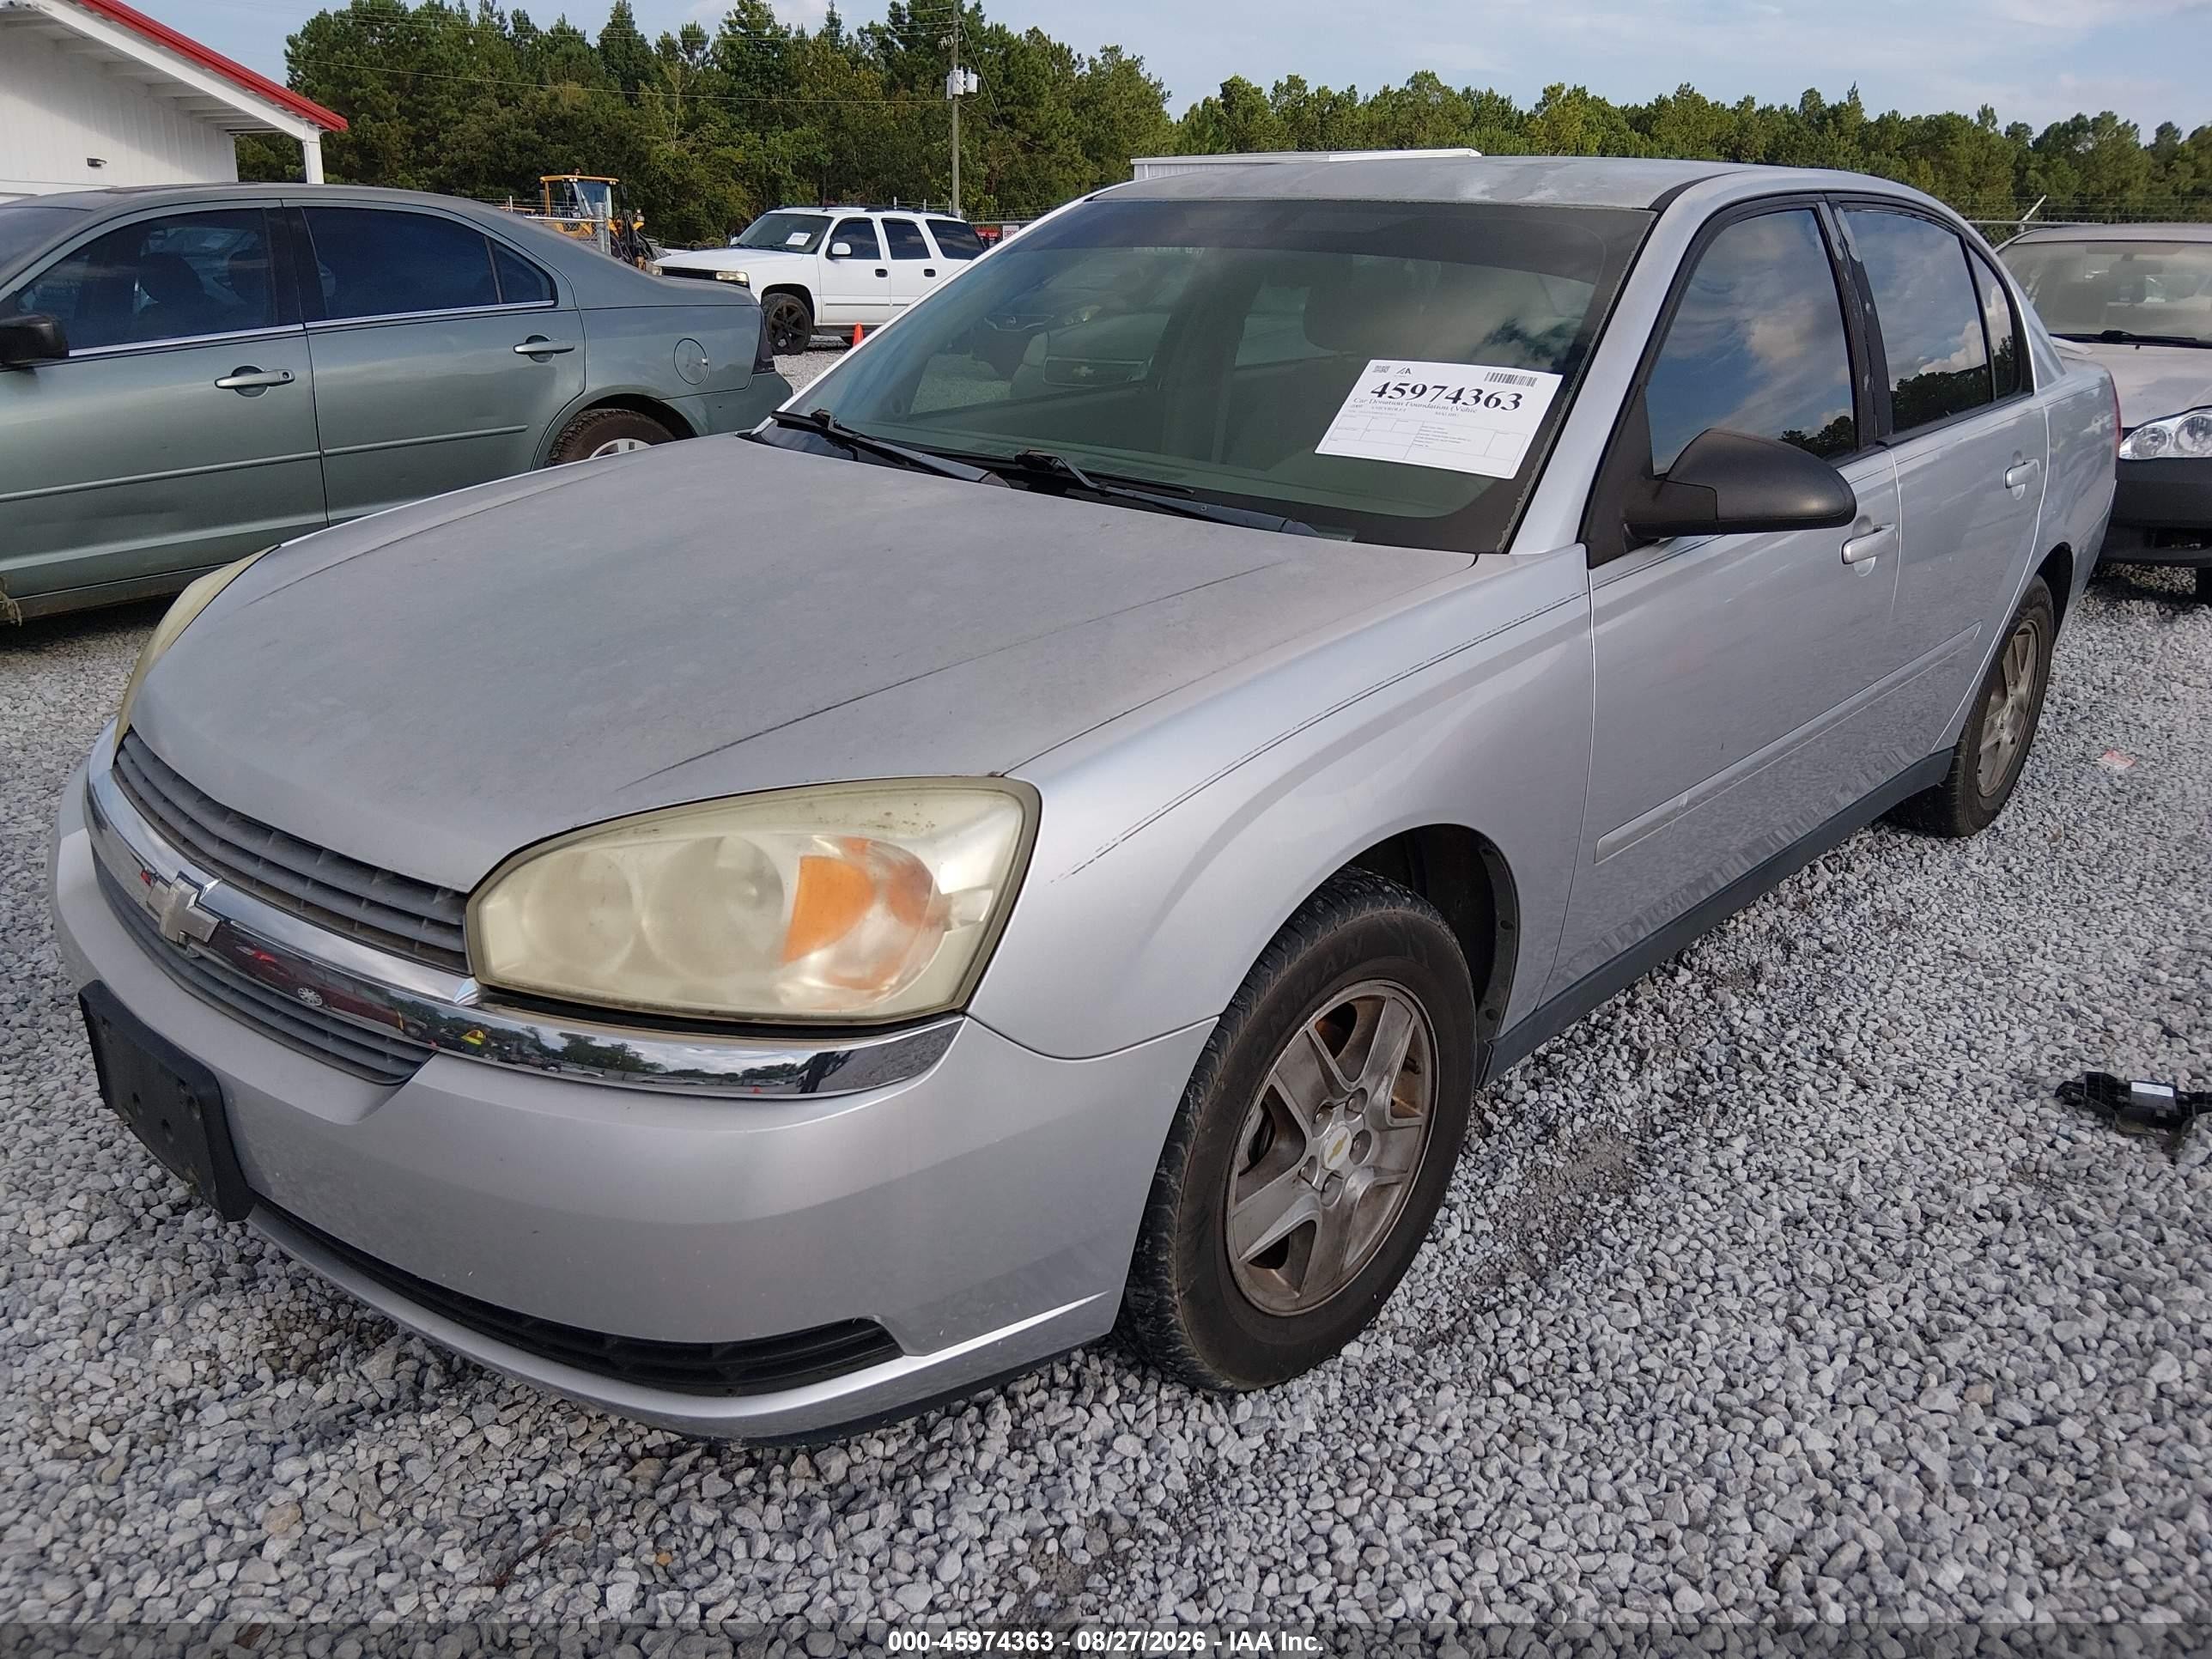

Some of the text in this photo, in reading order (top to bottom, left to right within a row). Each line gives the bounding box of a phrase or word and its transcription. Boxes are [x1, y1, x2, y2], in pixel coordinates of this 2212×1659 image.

[1369, 398, 1403, 407] Donation
[1405, 400, 1449, 410] Foundation
[1370, 381, 1522, 411] 45974363
